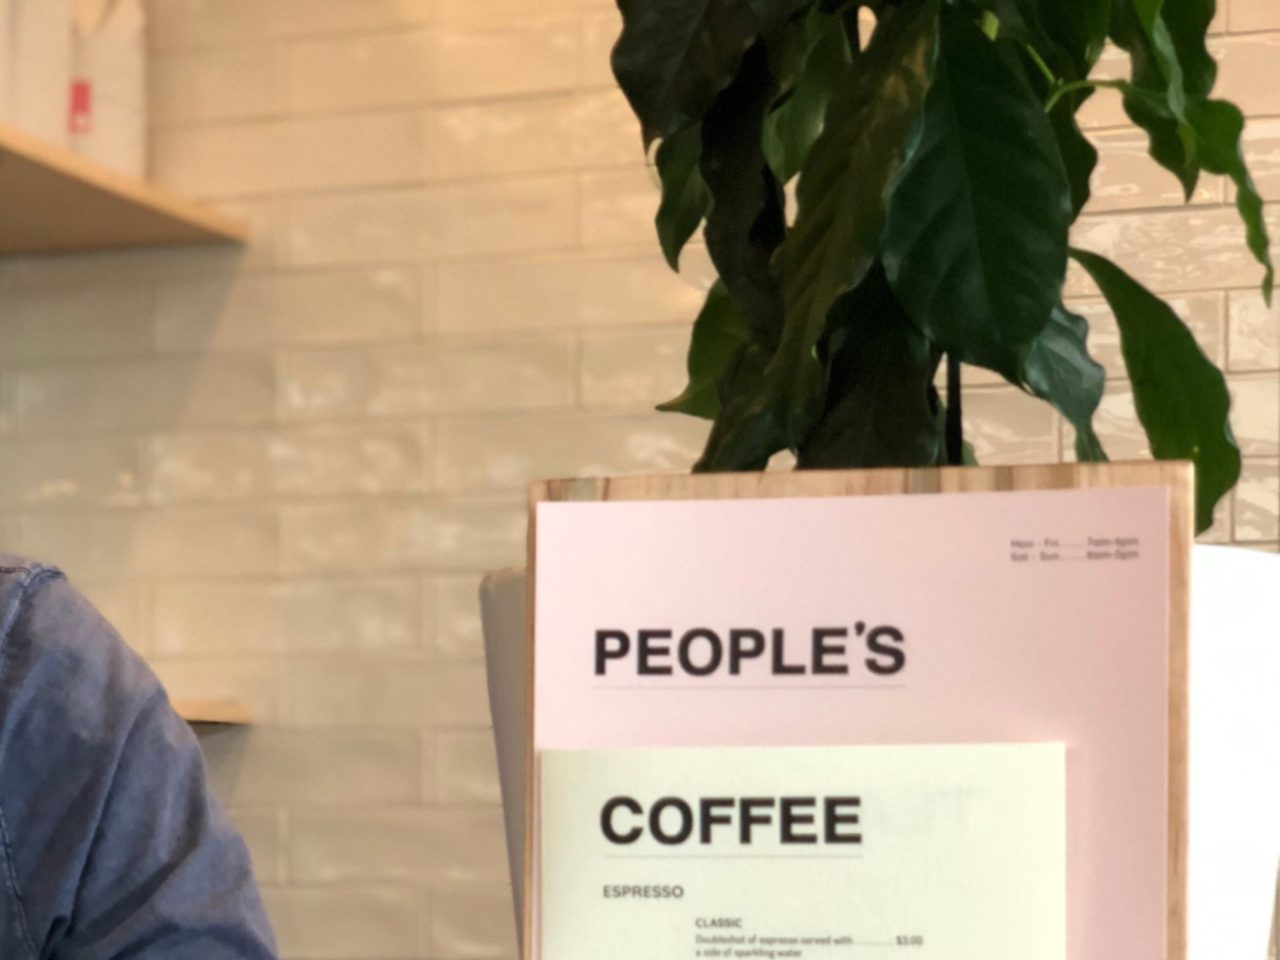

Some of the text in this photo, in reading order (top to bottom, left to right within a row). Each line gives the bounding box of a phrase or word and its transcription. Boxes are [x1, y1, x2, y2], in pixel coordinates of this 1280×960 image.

[593, 621, 906, 675] PEOPLE'S
[599, 796, 863, 845] COFFEE
[603, 885, 685, 898] ESPRESSO
[695, 917, 743, 928] CLASSIC
[695, 934, 924, 947] Doubleshot of espresso served with $3.00
[703, 948, 721, 957] side
[723, 948, 733, 957] of
[734, 948, 776, 960] sparkling
[777, 949, 803, 958] water
